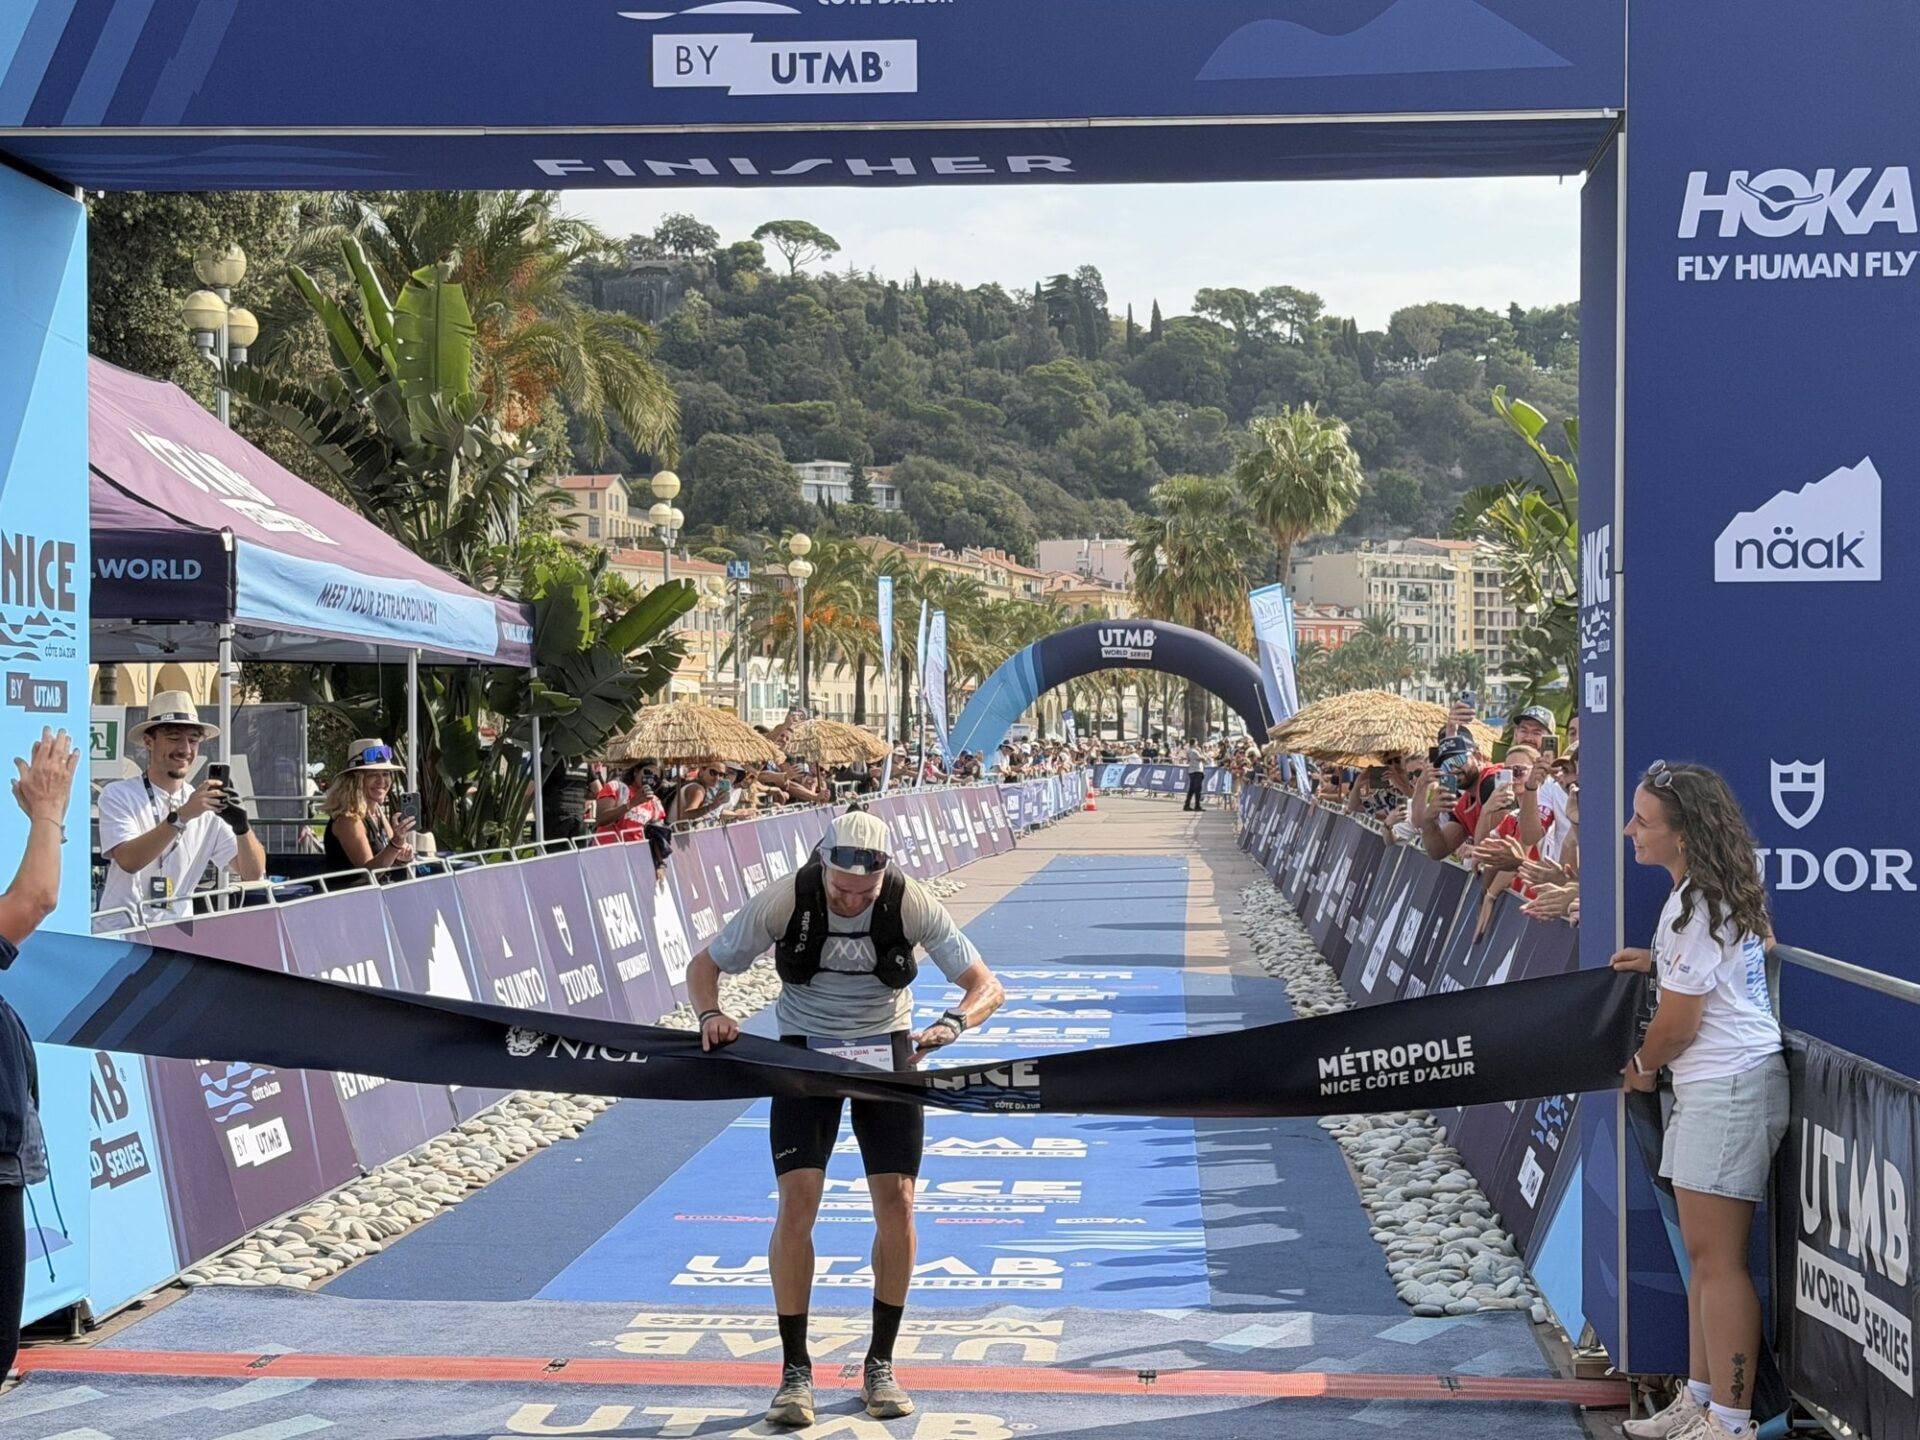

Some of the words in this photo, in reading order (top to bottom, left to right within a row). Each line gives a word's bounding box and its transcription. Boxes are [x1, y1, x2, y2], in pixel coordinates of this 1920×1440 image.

[676, 45, 719, 75] BY
[533, 155, 1075, 177] FINISHER
[1678, 166, 1918, 238] HOKA
[1678, 255, 1729, 281] FLY
[1735, 252, 1858, 280] HUMAN
[1865, 250, 1915, 277] FLY
[1583, 524, 1610, 608] NICE
[1735, 526, 1865, 570] näak
[1, 528, 76, 612] NICE
[315, 582, 348, 609] MEET
[346, 586, 375, 616] YOUR
[375, 592, 438, 626] EXTRAORDINARY
[1098, 628, 1155, 647] UTMB
[1103, 648, 1128, 656] WORLD
[1130, 650, 1150, 658] SERIES
[11, 678, 23, 700] BY
[33, 685, 61, 708] UTMB
[1752, 847, 1918, 892] DOR
[598, 892, 642, 950] HOKA
[494, 966, 546, 1009] SUUNTO
[558, 964, 603, 1006] TUDOR
[1318, 1035, 1473, 1079] MÉTROPOLE
[1320, 1078, 1361, 1096] NICE
[1366, 1071, 1410, 1090] CÔTE
[1414, 1061, 1475, 1083] D'AZUR
[107, 1142, 145, 1179] SERIES
[234, 1135, 249, 1157] BY
[255, 1126, 283, 1155] UTMB
[1801, 1117, 1910, 1287] UTMB
[694, 1276, 873, 1284] WOLD
[1799, 1257, 1861, 1325] WORLD
[650, 1316, 818, 1327] ERIES
[843, 1321, 1043, 1333] WORD
[1864, 1306, 1910, 1377] SERIES
